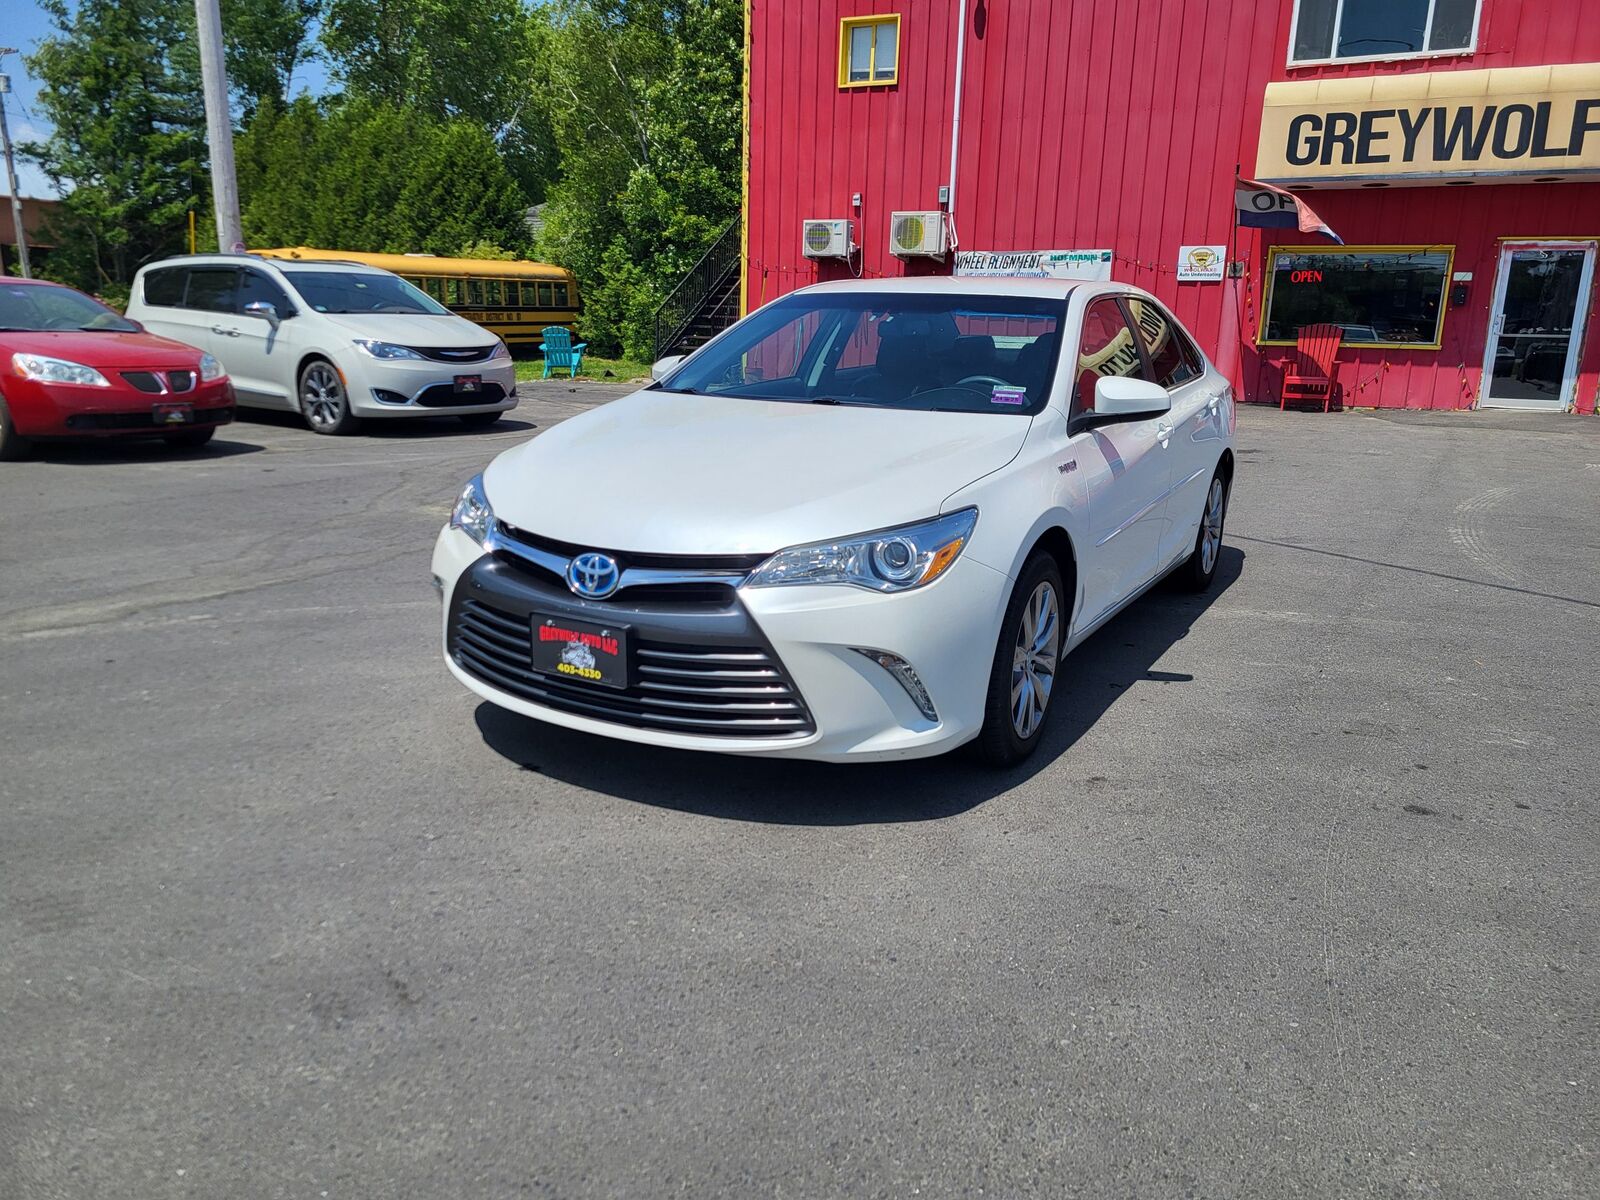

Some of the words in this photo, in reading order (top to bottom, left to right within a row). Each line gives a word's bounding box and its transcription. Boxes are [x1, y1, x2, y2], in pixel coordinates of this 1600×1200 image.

[1286, 99, 1600, 166] GREYWOLF
[956, 255, 986, 269] WHEEL
[987, 254, 1043, 269] ALIGNMENT
[1050, 253, 1098, 262] HOFMANN
[1291, 270, 1323, 283] OPEN
